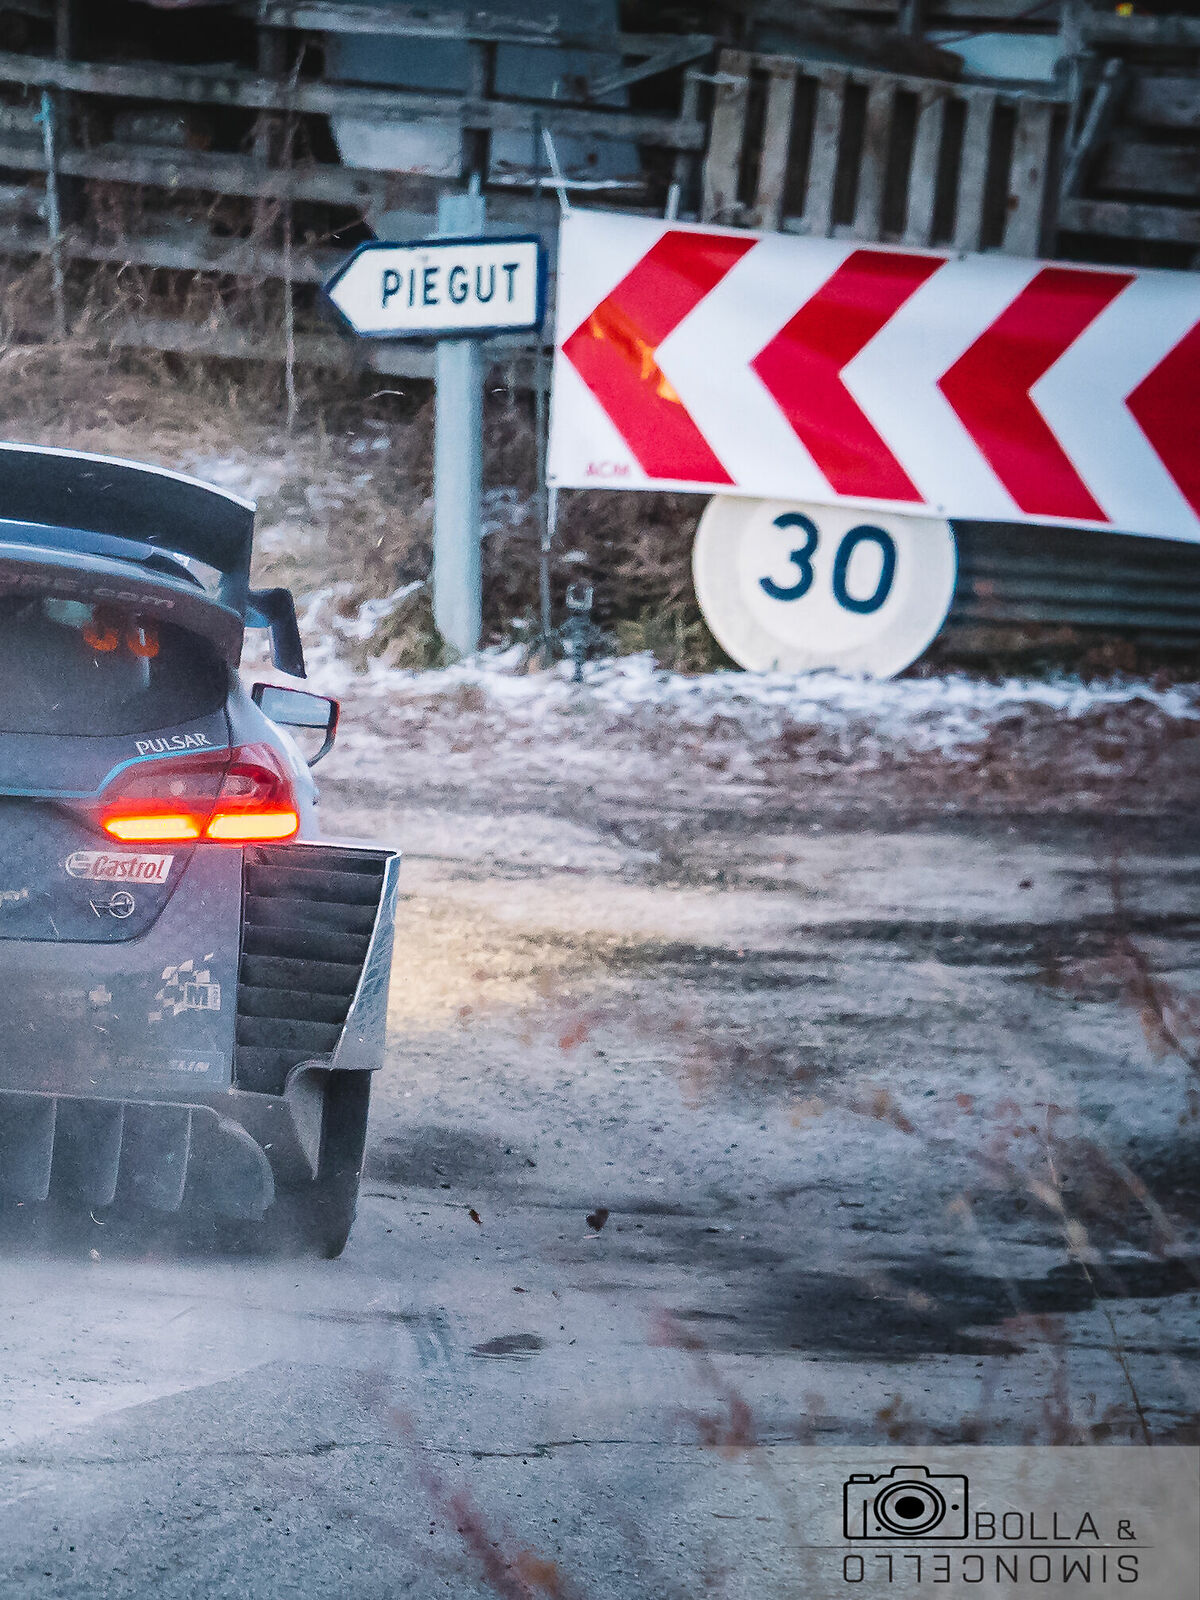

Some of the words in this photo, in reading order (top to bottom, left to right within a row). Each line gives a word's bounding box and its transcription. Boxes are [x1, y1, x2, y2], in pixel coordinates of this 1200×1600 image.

[382, 263, 521, 309] PIEGUT
[759, 512, 897, 614] 30
[135, 733, 211, 755] PULSAR
[92, 855, 165, 880] Castrol
